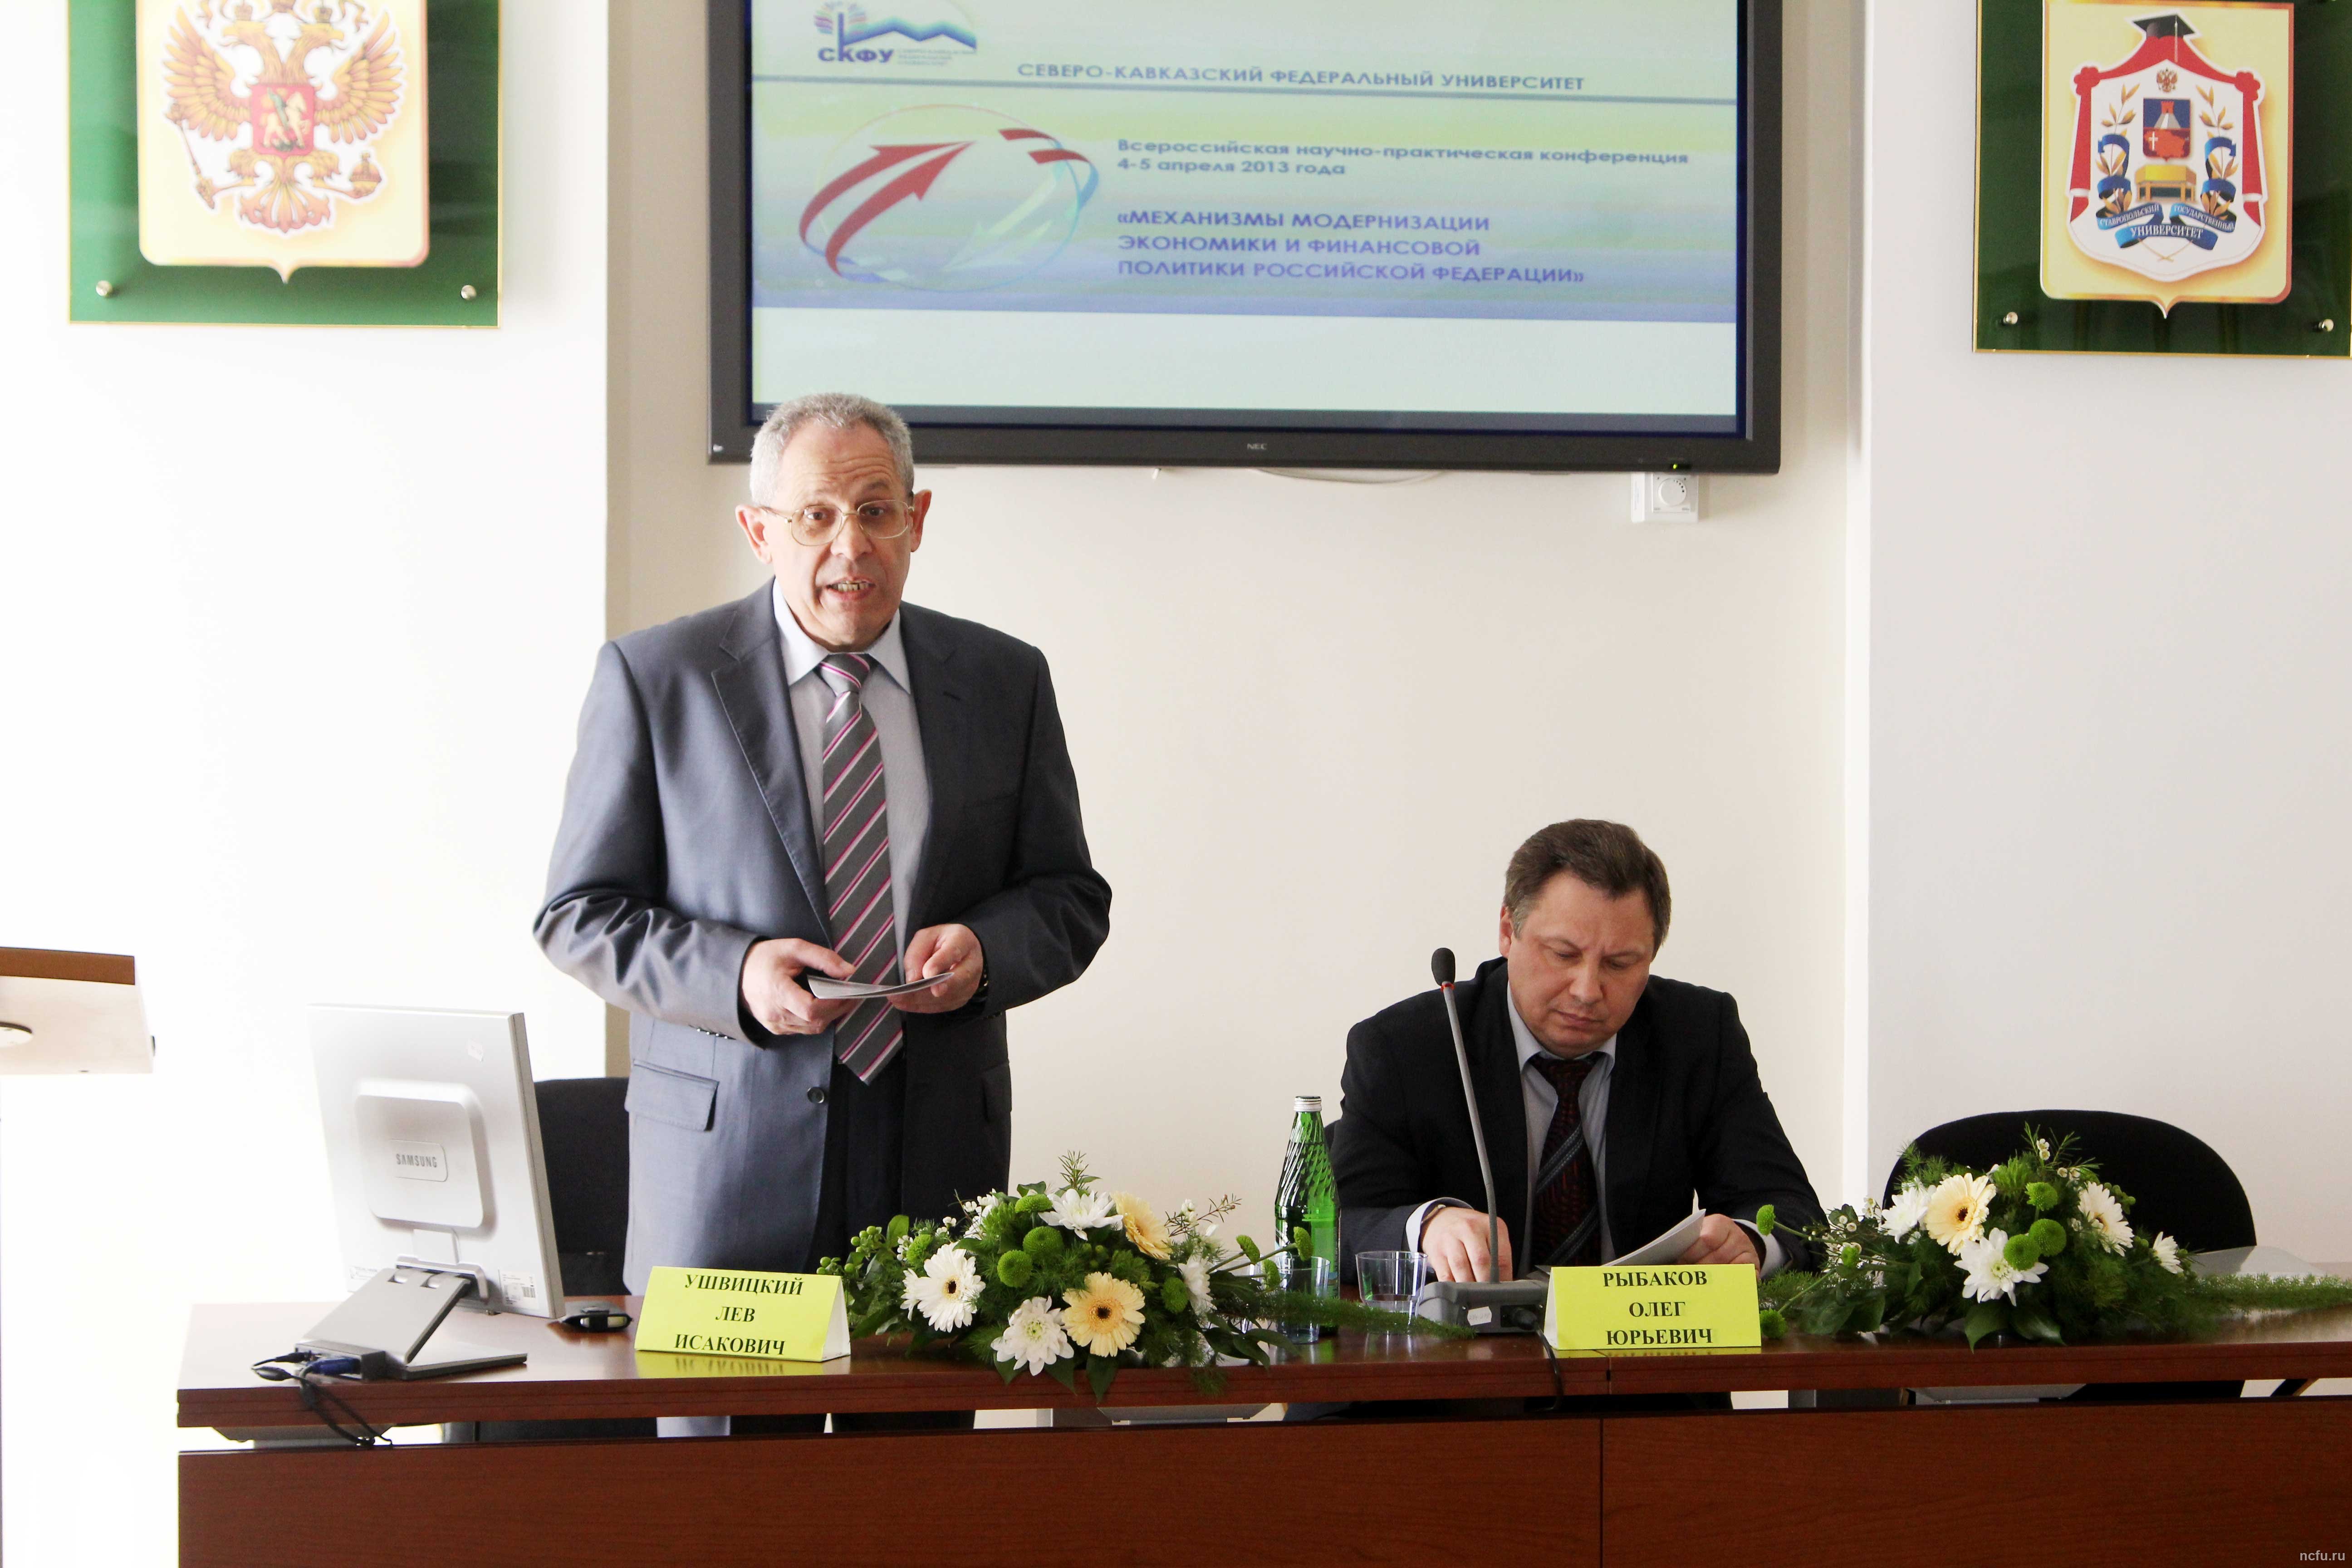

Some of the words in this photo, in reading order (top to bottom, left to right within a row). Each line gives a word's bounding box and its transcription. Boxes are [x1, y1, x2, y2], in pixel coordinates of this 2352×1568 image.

[818, 47, 894, 63] СКФУ
[1017, 64, 1263, 83] СЕВЕРО-КАВКАЗСКИЙ
[1270, 69, 1433, 86] ФЕДЕРАЛЬНЫЙ
[1441, 74, 1585, 90] УНИВЕРСИТЕТ
[1118, 139, 1289, 155] Всероссийская
[1296, 145, 1533, 161] научно-практическая
[1540, 147, 1689, 164] конференция
[1117, 158, 1151, 170] 4-5
[1158, 162, 1235, 173] апреля
[1241, 161, 1289, 174] 2013
[1296, 163, 1346, 176] года
[1117, 211, 1284, 227] «МЕХАНИЗМЫ
[1292, 213, 1490, 232] МОДЕРНИЗАЦИИ
[2100, 204, 2160, 225] СТАВРОПОЛЬСКИЙ
[2174, 205, 2235, 230] ГОСУДАРСТВЕННЫЙ
[2130, 224, 2204, 238] УНИВЕРСИТЕТ
[1118, 235, 1276, 252] ЭКОНОМИКИ
[1286, 239, 1300, 252] И
[1308, 238, 1480, 255] ФИНАНСОВОЙ
[1118, 260, 1244, 276] ПОЛИТИКИ
[1254, 261, 1425, 279] РОССИЙСКОЙ
[1432, 266, 1585, 284] ФЕДЕРАЦИИ»
[396, 1153, 437, 1168] SAMSUNG
[684, 1274, 804, 1296] УШВИЦКИЙ
[1602, 1271, 1708, 1287] РЫБАКОВ
[715, 1306, 755, 1323] ЛЕВ
[1629, 1301, 1686, 1317] ОЛЕГ
[674, 1334, 785, 1355] ИСАКОВИЧ
[1607, 1328, 1713, 1345] ЮРЬЕВИЧ
